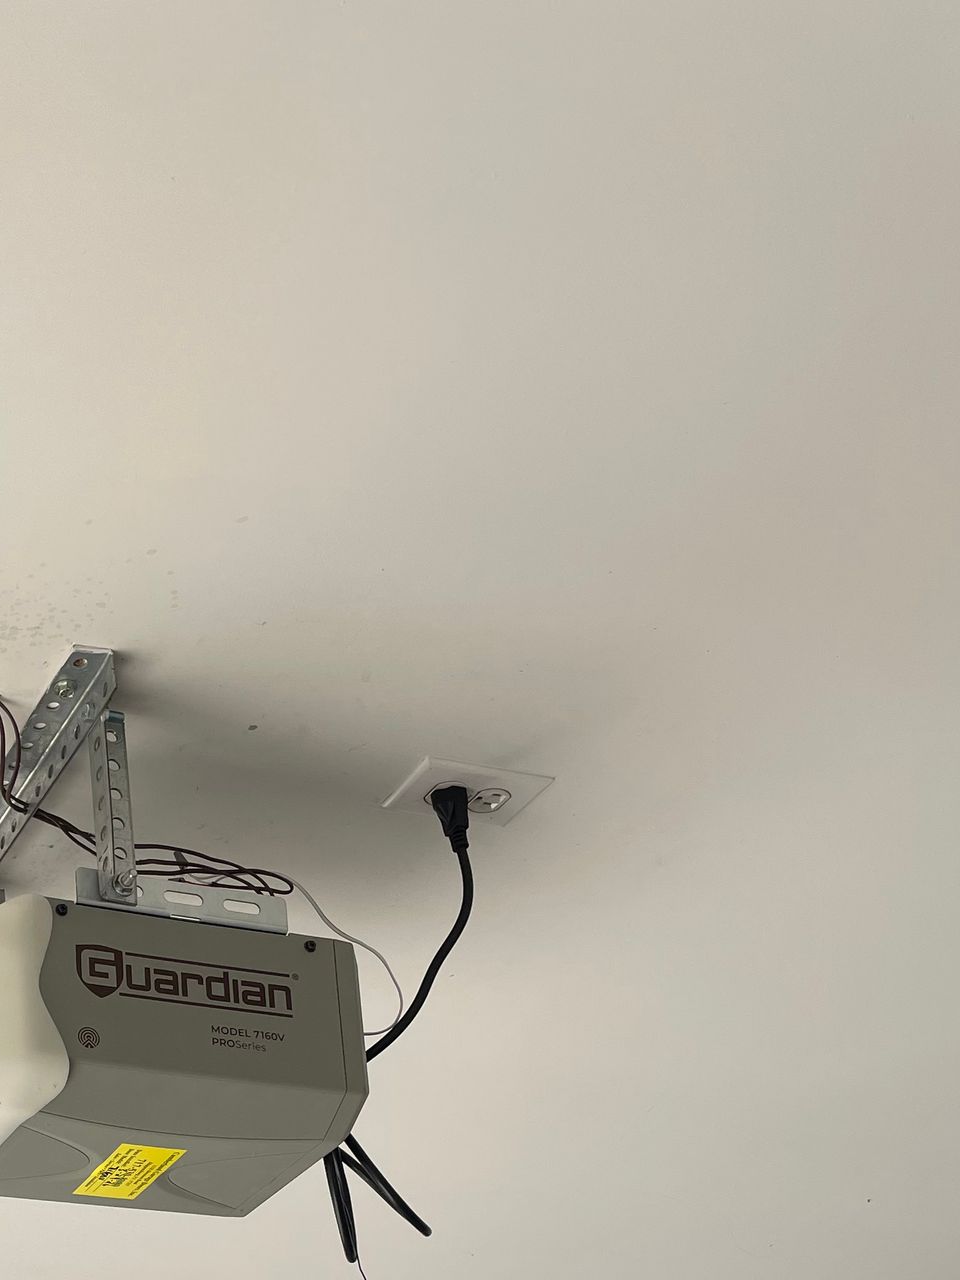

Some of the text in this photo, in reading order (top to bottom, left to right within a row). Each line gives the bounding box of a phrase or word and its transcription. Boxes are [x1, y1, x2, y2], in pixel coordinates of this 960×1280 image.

[75, 944, 293, 1011] Guardian
[211, 1024, 285, 1042] MODEL 7160V
[211, 1037, 266, 1052] PROSeries
